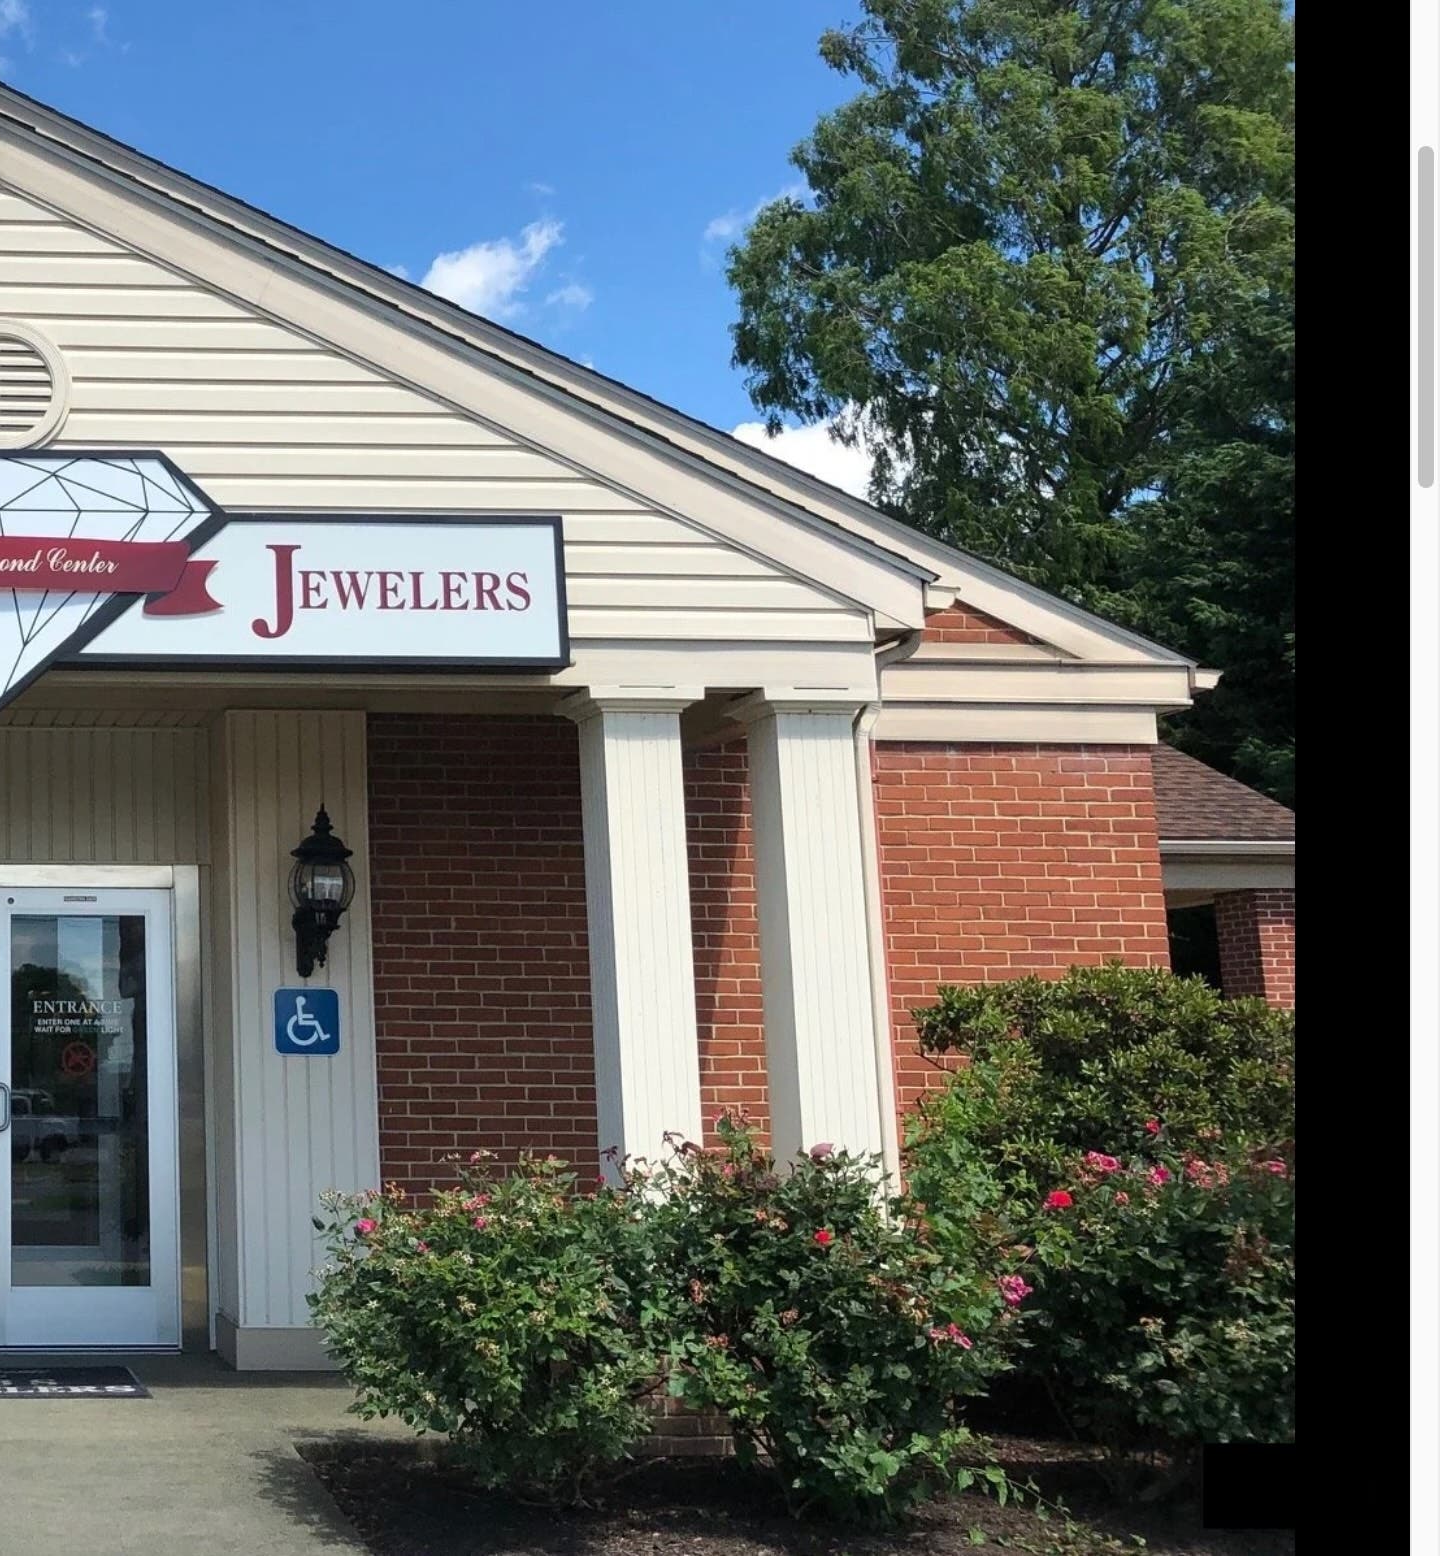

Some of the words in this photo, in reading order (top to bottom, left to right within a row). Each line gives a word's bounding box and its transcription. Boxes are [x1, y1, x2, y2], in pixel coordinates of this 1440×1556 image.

[46, 547, 119, 573] Center
[252, 544, 532, 639] JEWELERS
[33, 1000, 122, 1014] ENTRANCE
[37, 1018, 62, 1026] ENTER
[64, 1018, 80, 1026] ONE
